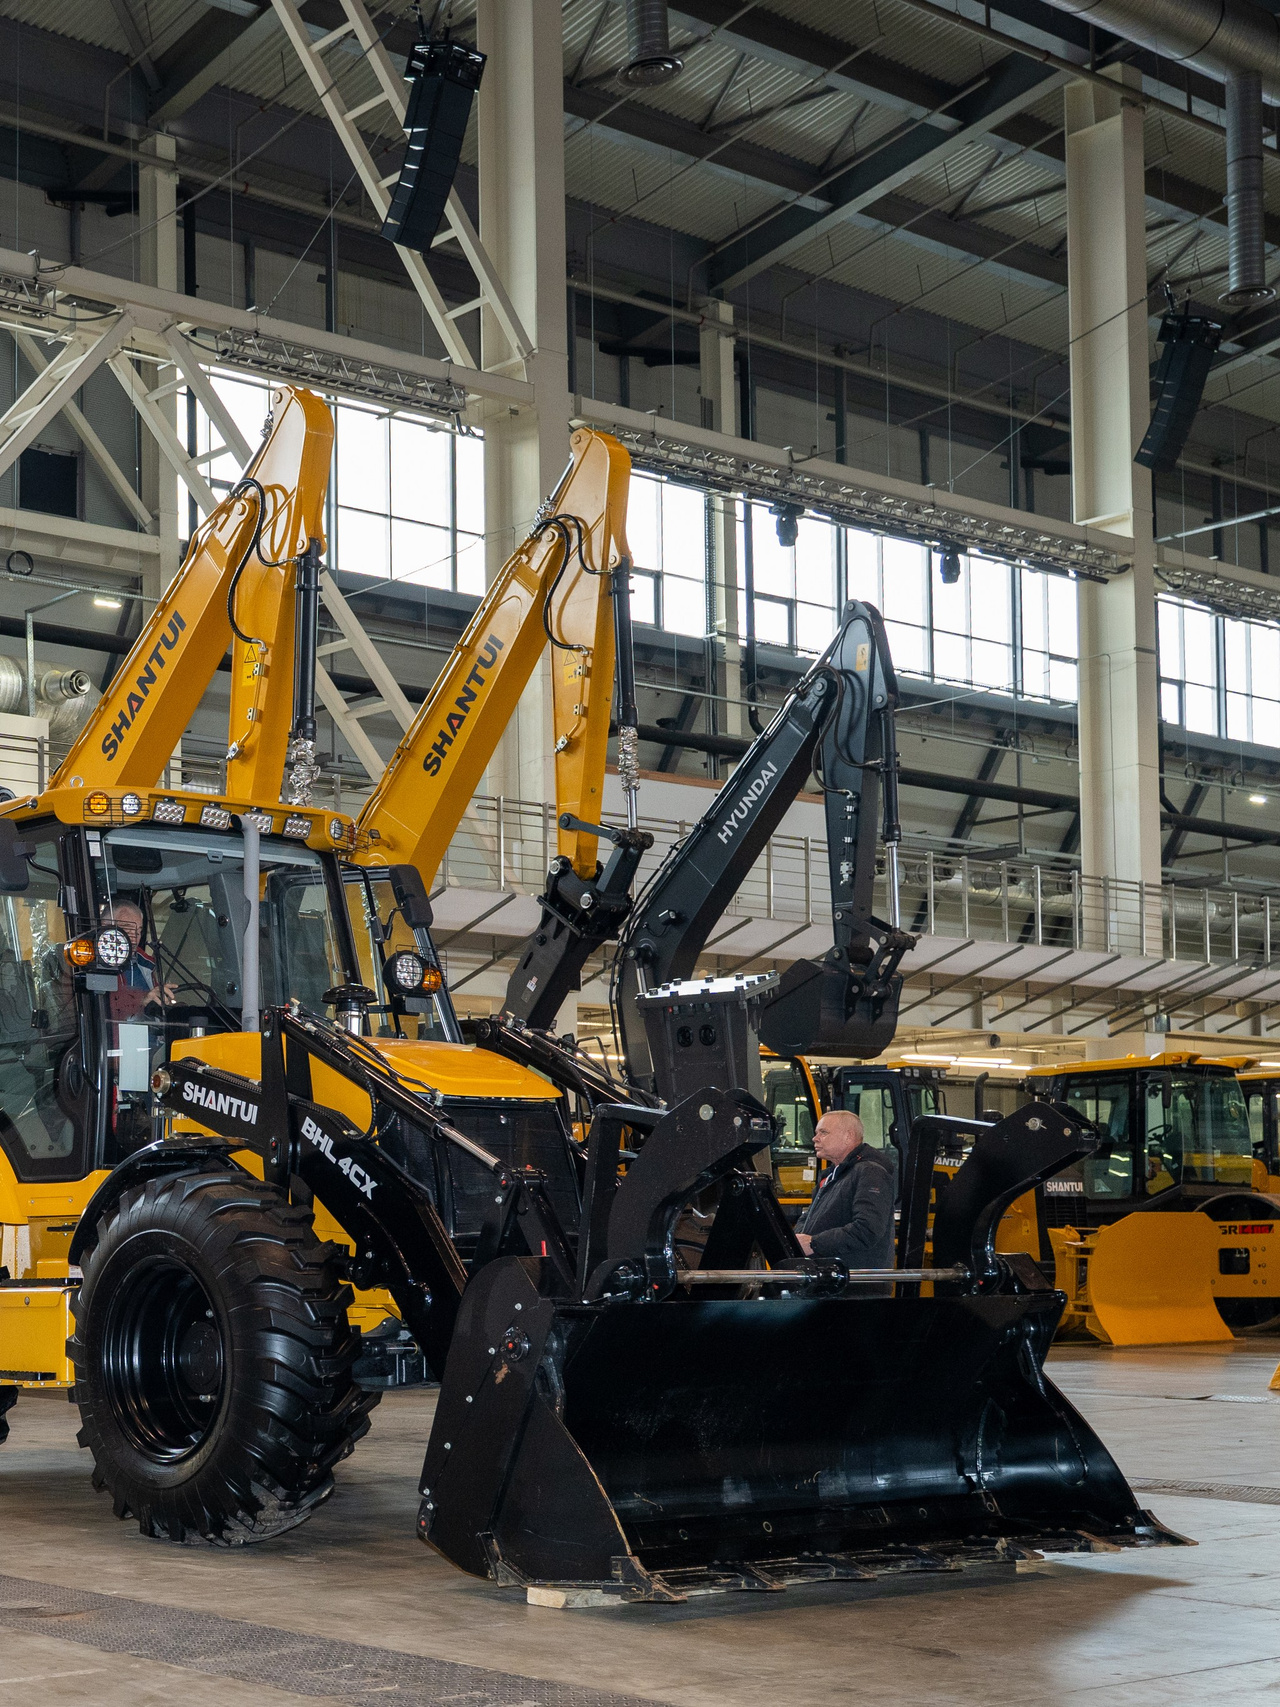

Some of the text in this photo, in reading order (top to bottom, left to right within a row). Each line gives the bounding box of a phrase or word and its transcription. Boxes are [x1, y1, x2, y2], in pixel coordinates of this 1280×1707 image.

[101, 609, 187, 762] SHANTUI
[422, 633, 505, 778] SHANTUI
[717, 760, 779, 845] HYUNDAI
[182, 1081, 259, 1125] SHANTUI
[1046, 1181, 1084, 1193] SHANTUI
